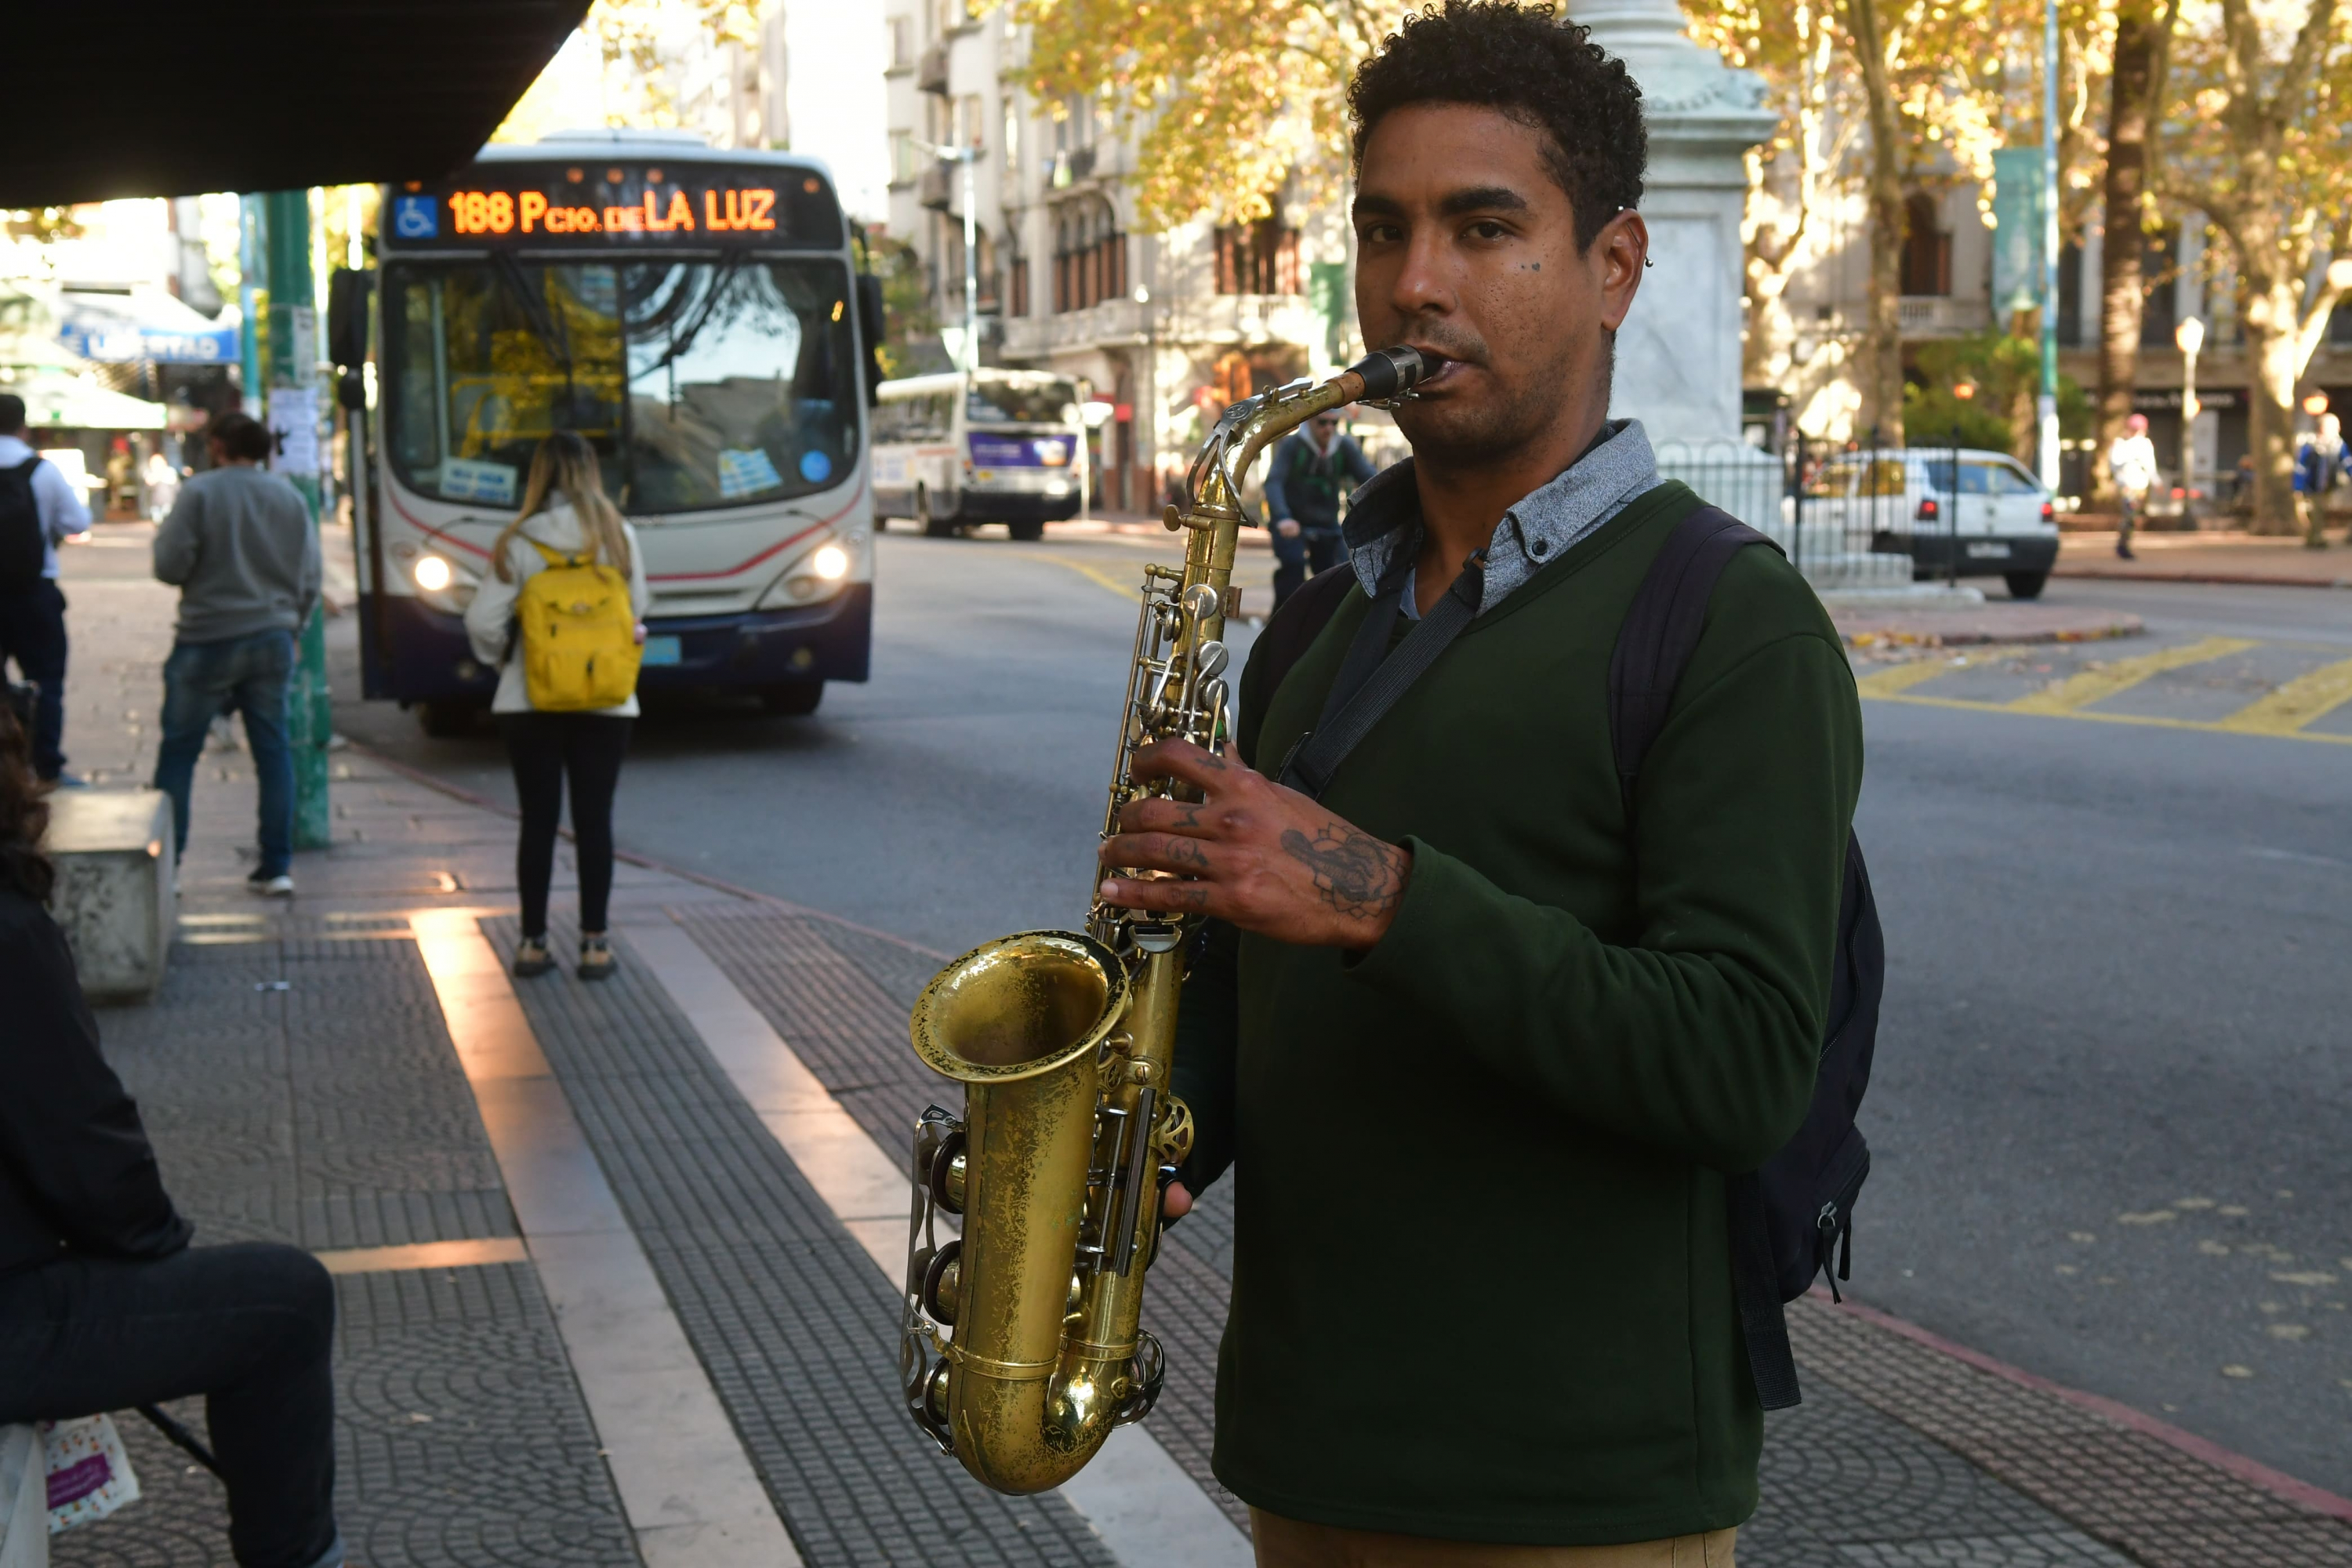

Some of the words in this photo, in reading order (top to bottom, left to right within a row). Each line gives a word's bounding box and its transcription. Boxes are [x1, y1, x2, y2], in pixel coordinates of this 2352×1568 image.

[449, 191, 514, 233] 188
[644, 190, 695, 231] LA
[705, 189, 775, 230] LUZ
